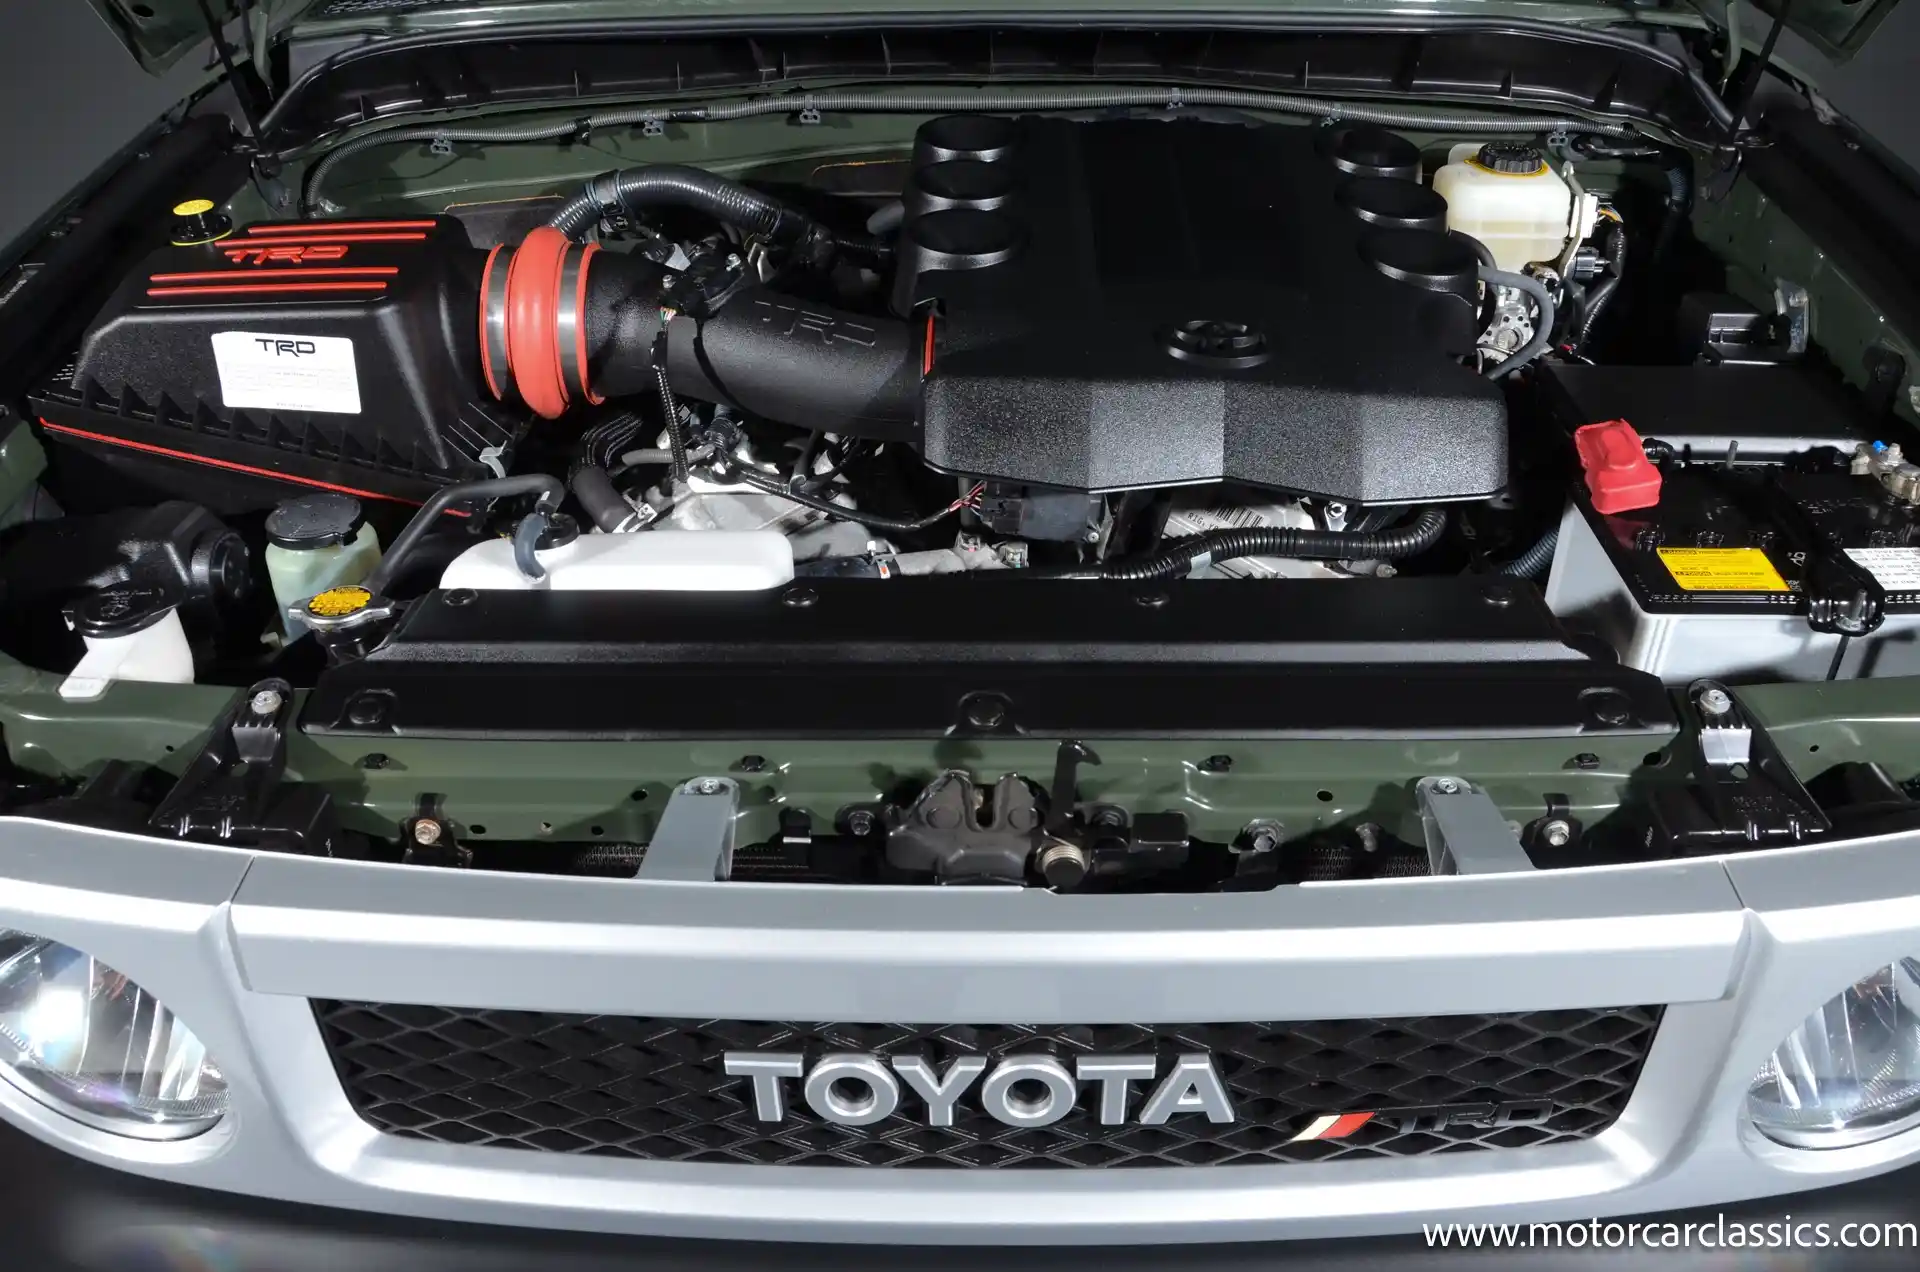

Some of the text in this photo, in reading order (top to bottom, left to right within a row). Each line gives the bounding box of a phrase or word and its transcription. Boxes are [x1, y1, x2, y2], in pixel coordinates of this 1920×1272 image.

[224, 246, 349, 265] TRD
[255, 338, 316, 357] TRD
[724, 1053, 1235, 1128] TOYOTA
[1380, 1098, 1554, 1132] TRD
